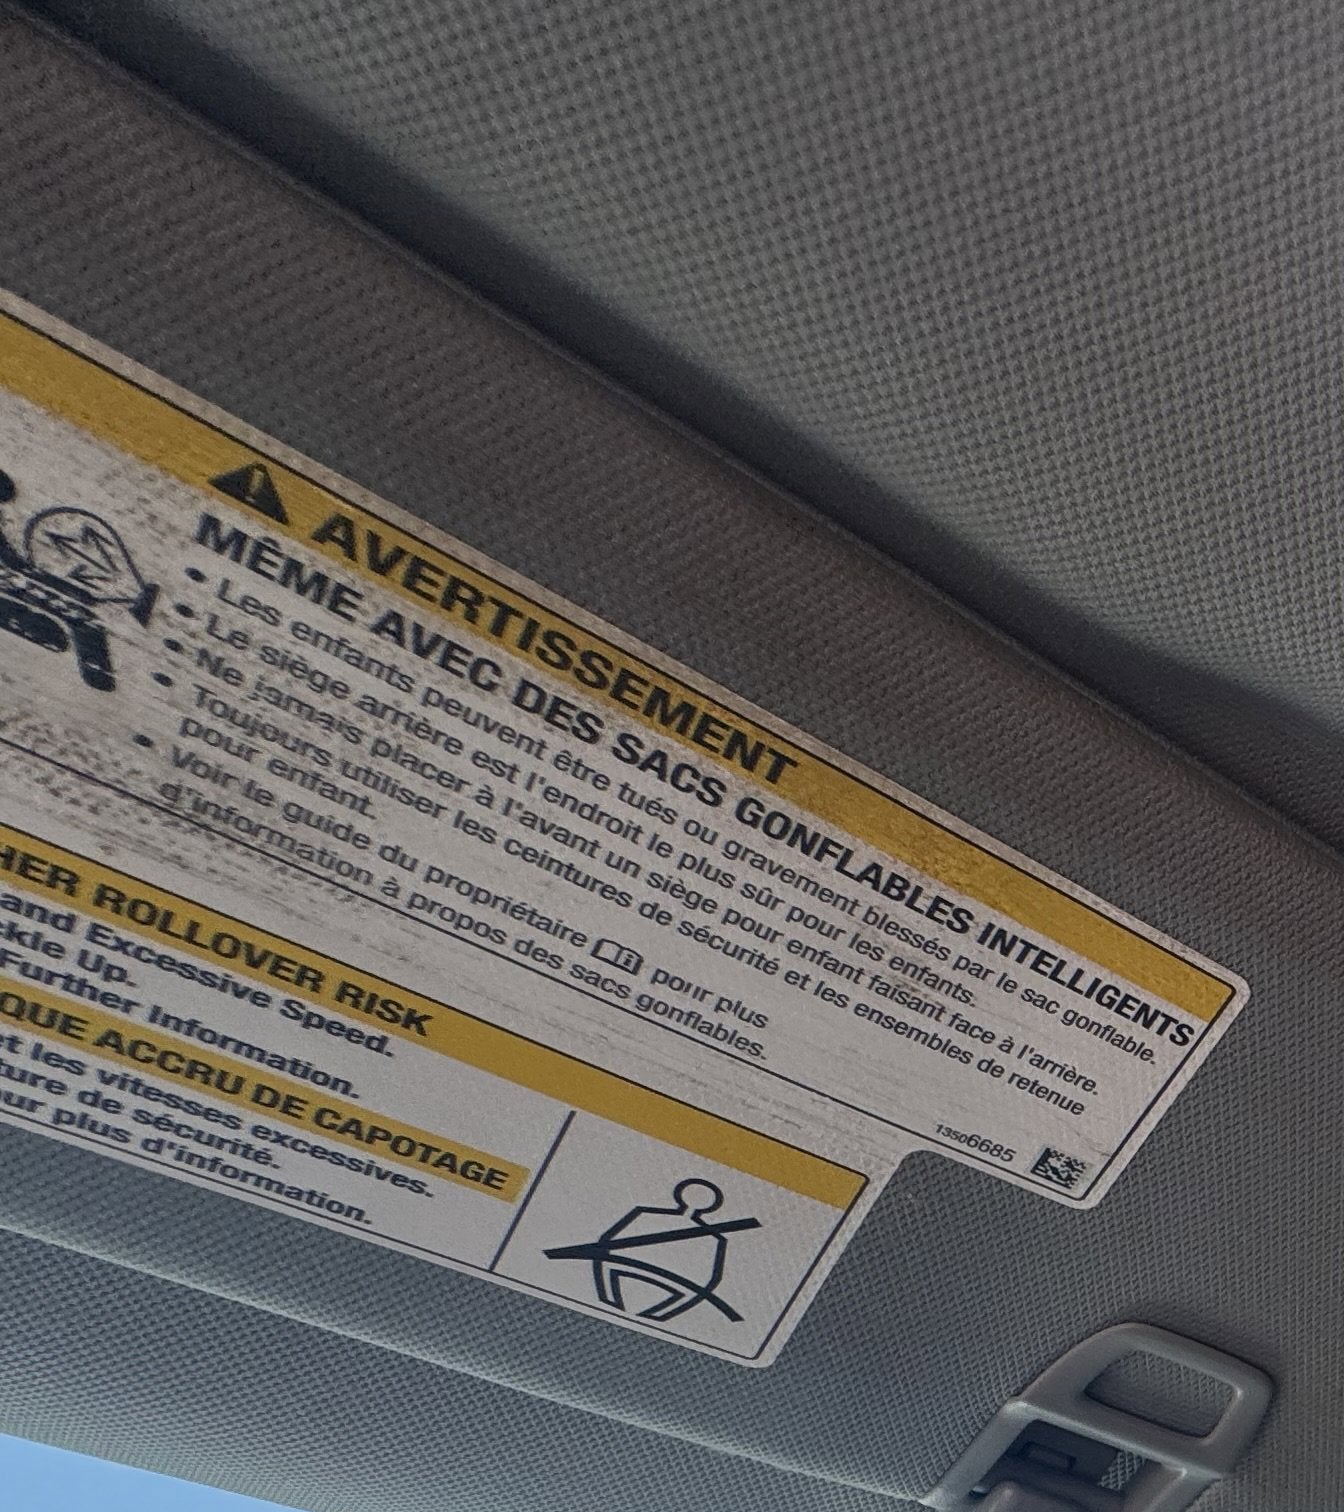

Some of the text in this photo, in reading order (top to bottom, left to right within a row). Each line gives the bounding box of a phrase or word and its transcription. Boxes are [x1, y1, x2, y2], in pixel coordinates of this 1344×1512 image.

[308, 511, 801, 786] AVERTISSEMENT
[178, 716, 376, 820] pour enfant.
[191, 511, 1195, 1047] MÊME AVEC DES SACS GONFLABLES INTELLIGENTS
[204, 611, 976, 1008] Le siège arrière est l'endroit le plus sûr pour les enfants.
[216, 577, 1156, 1065] Les enfants peuvent être tués ou gravement blessés par le sac gonflable.
[157, 782, 766, 1060] d'information à propos des sacs gonflables.
[170, 743, 240, 789] Voir
[240, 778, 276, 808] le
[281, 801, 372, 850] guide
[377, 844, 419, 873] du
[422, 864, 588, 947] propriétaire
[712, 995, 769, 1029] plus
[192, 683, 1085, 1115] Toujours utiliser les ceintures de sécurité et les ensembles de retenue
[193, 646, 1098, 1095] Ne jamais placer à l'avant un siège pour enfant faisant face à l'arrière.
[0, 920, 137, 988] kle Up.
[0, 892, 394, 1058] and Excessive Speed.
[0, 945, 360, 1099] Further Information.
[91, 882, 326, 995] ROLLOVER
[331, 979, 434, 1037] RISK
[0, 1087, 372, 1225] ur plus d'information.
[29, 1041, 88, 1076] les
[96, 1068, 243, 1130] vitesses
[249, 1123, 434, 1198] excessives.
[76, 1089, 125, 1115] de
[130, 1108, 280, 1169] sécurité.
[90, 1028, 247, 1096] ACCRU
[249, 1082, 310, 1120] DE
[311, 1106, 510, 1191] CAPOTAGE
[935, 1123, 1017, 1162] 13506685
